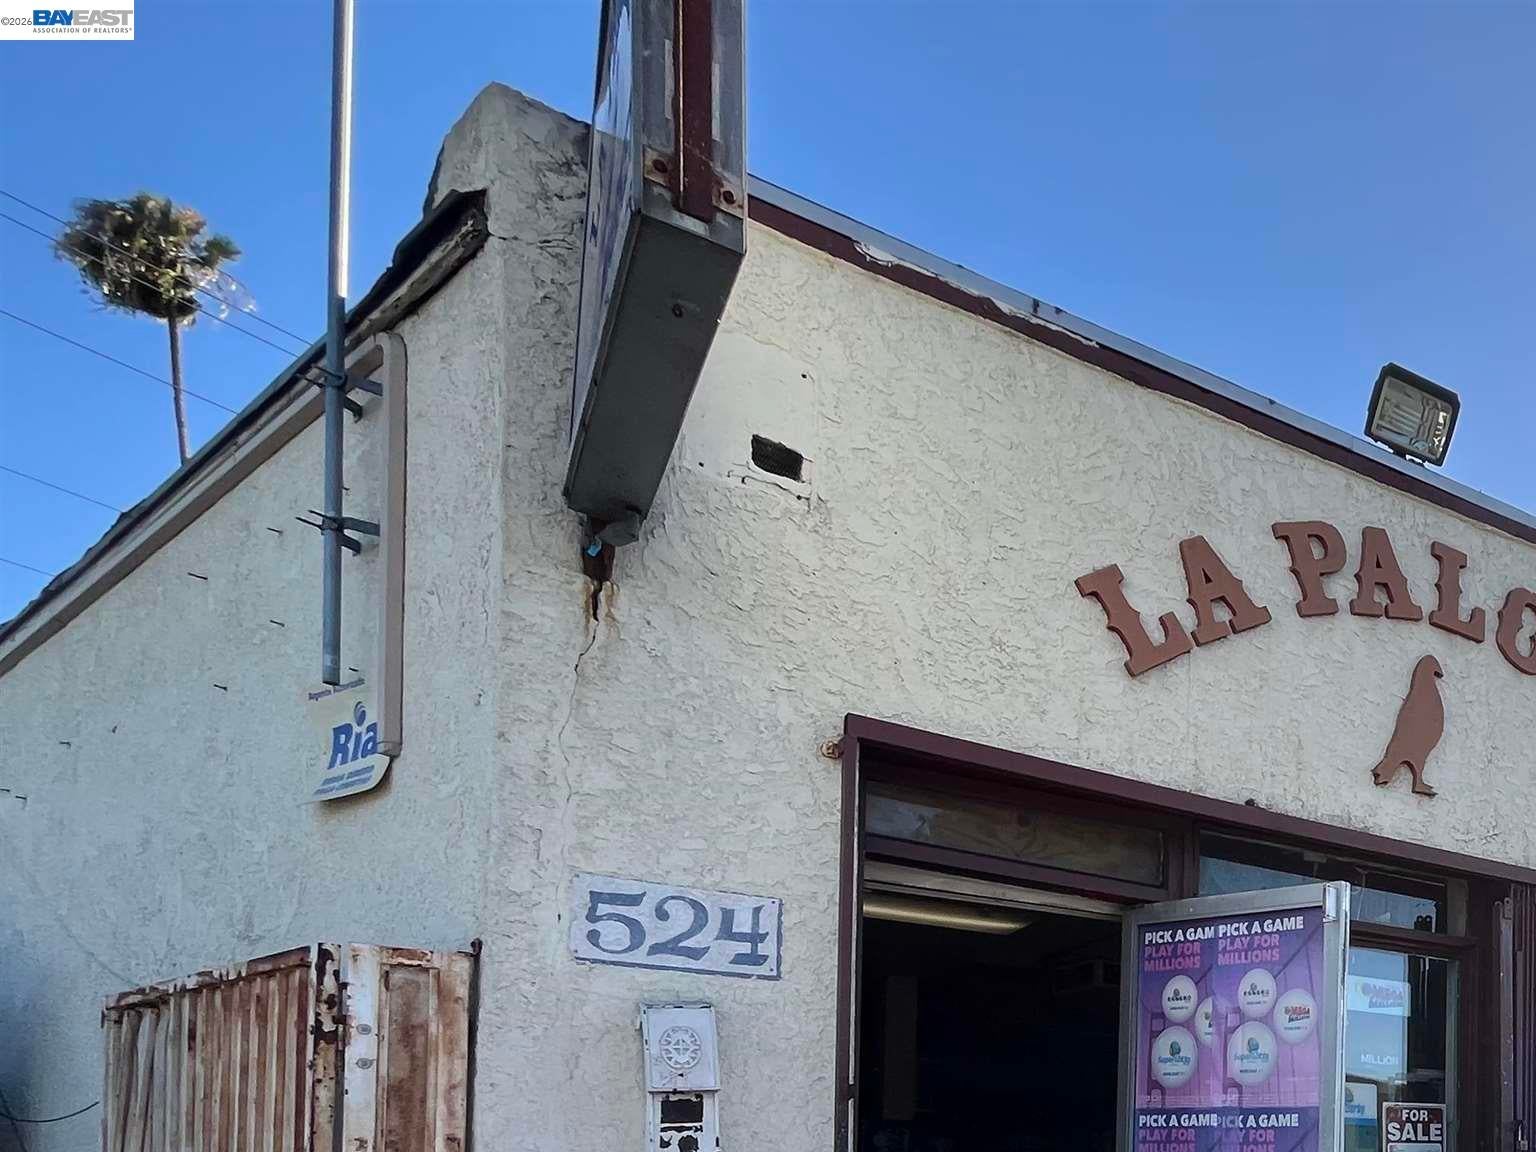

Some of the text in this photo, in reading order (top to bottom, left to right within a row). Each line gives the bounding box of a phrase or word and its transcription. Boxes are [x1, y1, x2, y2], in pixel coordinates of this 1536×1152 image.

[1075, 534, 1272, 678] LA
[327, 700, 379, 770] Ria
[585, 890, 769, 967] 524
[1145, 926, 1215, 945] PICK A GAM
[1218, 916, 1304, 938] PICK A GAME
[1144, 941, 1201, 958] PLAY FOR
[1218, 934, 1280, 951] PLAY FOR
[1144, 956, 1201, 972] MILLIONS
[1217, 949, 1280, 966] MILLIONS
[1139, 1113, 1217, 1127] PICK A GAME
[1247, 1115, 1257, 1128] A
[1259, 1114, 1299, 1127] GAME
[1402, 1109, 1429, 1122] FOR
[1138, 1129, 1195, 1142] PLAY FOR
[1251, 1129, 1275, 1142] FOR
[1387, 1122, 1443, 1142] SALE
